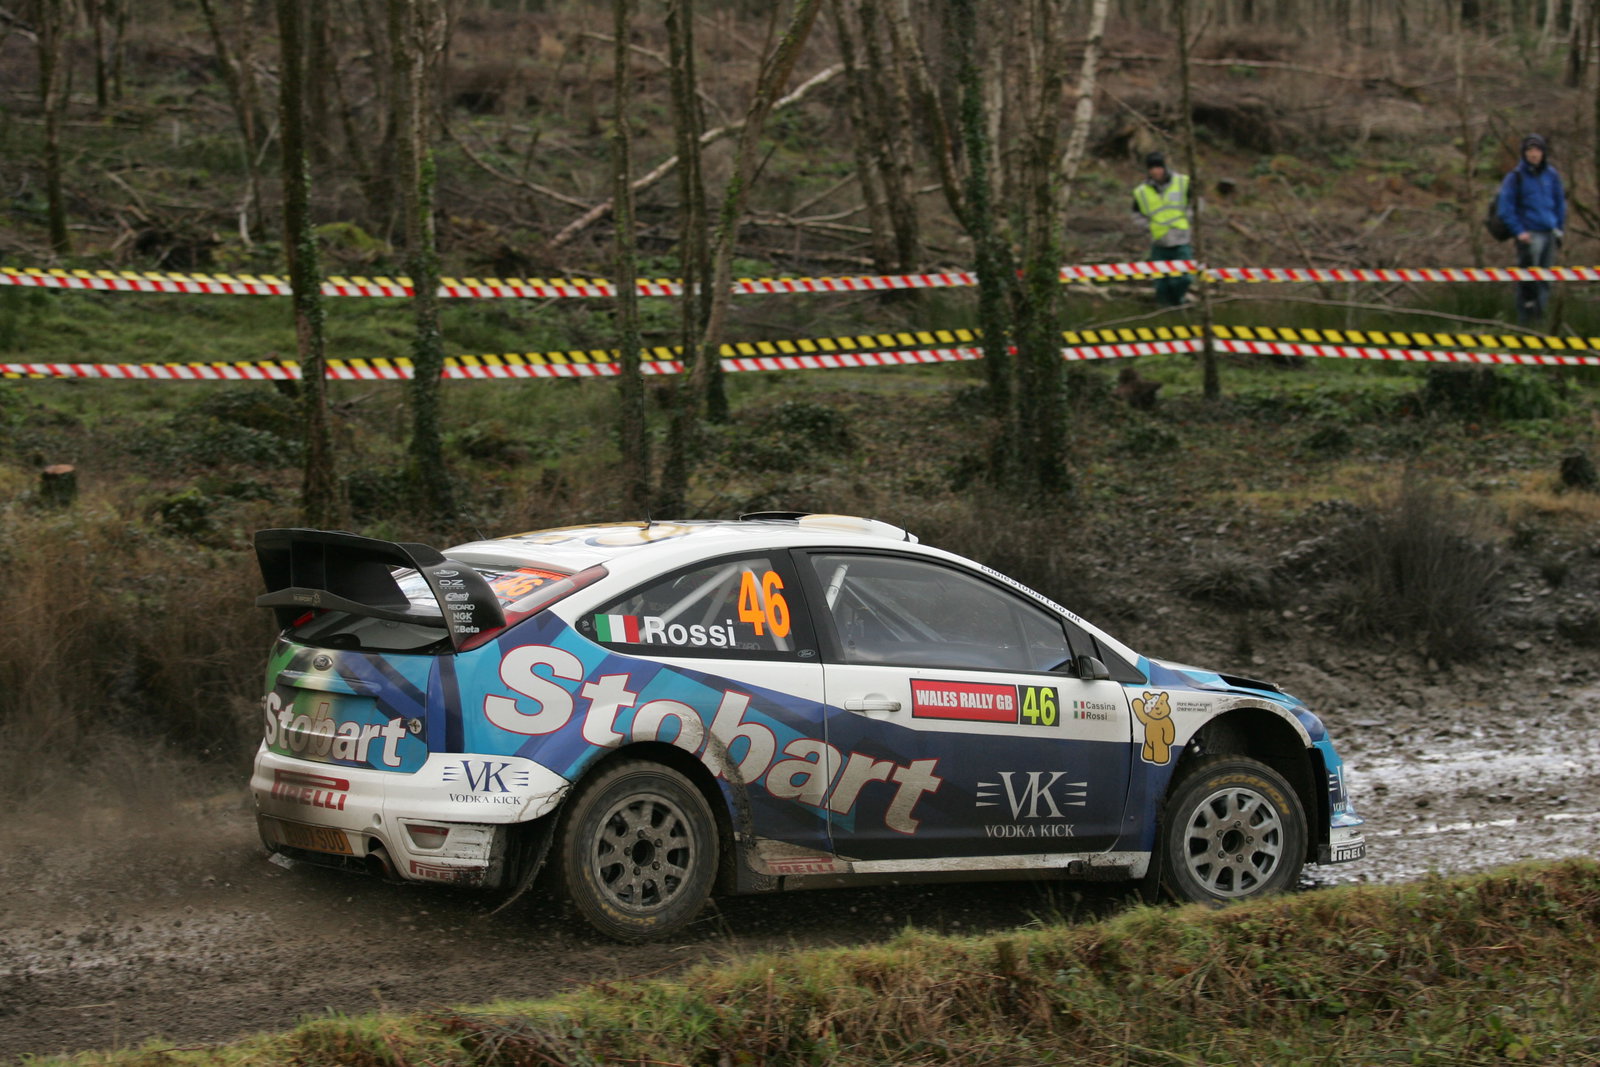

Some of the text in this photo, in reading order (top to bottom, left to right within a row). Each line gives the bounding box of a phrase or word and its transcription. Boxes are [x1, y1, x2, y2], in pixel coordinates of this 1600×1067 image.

[452, 612, 472, 620] NGK
[737, 570, 791, 638] 46
[643, 615, 736, 647] Rossi
[915, 689, 1014, 711] WALES RALLY GB
[1022, 687, 1056, 726] 46
[1086, 701, 1116, 711] Cassina
[1086, 711, 1108, 720] Rossi
[264, 691, 407, 767] Stobart
[484, 644, 943, 835] Stobart
[271, 768, 350, 812] PIRELLI
[460, 760, 512, 793] VK
[449, 793, 521, 805] VODKA KICK
[997, 771, 1069, 821] VK
[1207, 773, 1291, 815] SCORPION
[984, 824, 1075, 838] VODKA KICK
